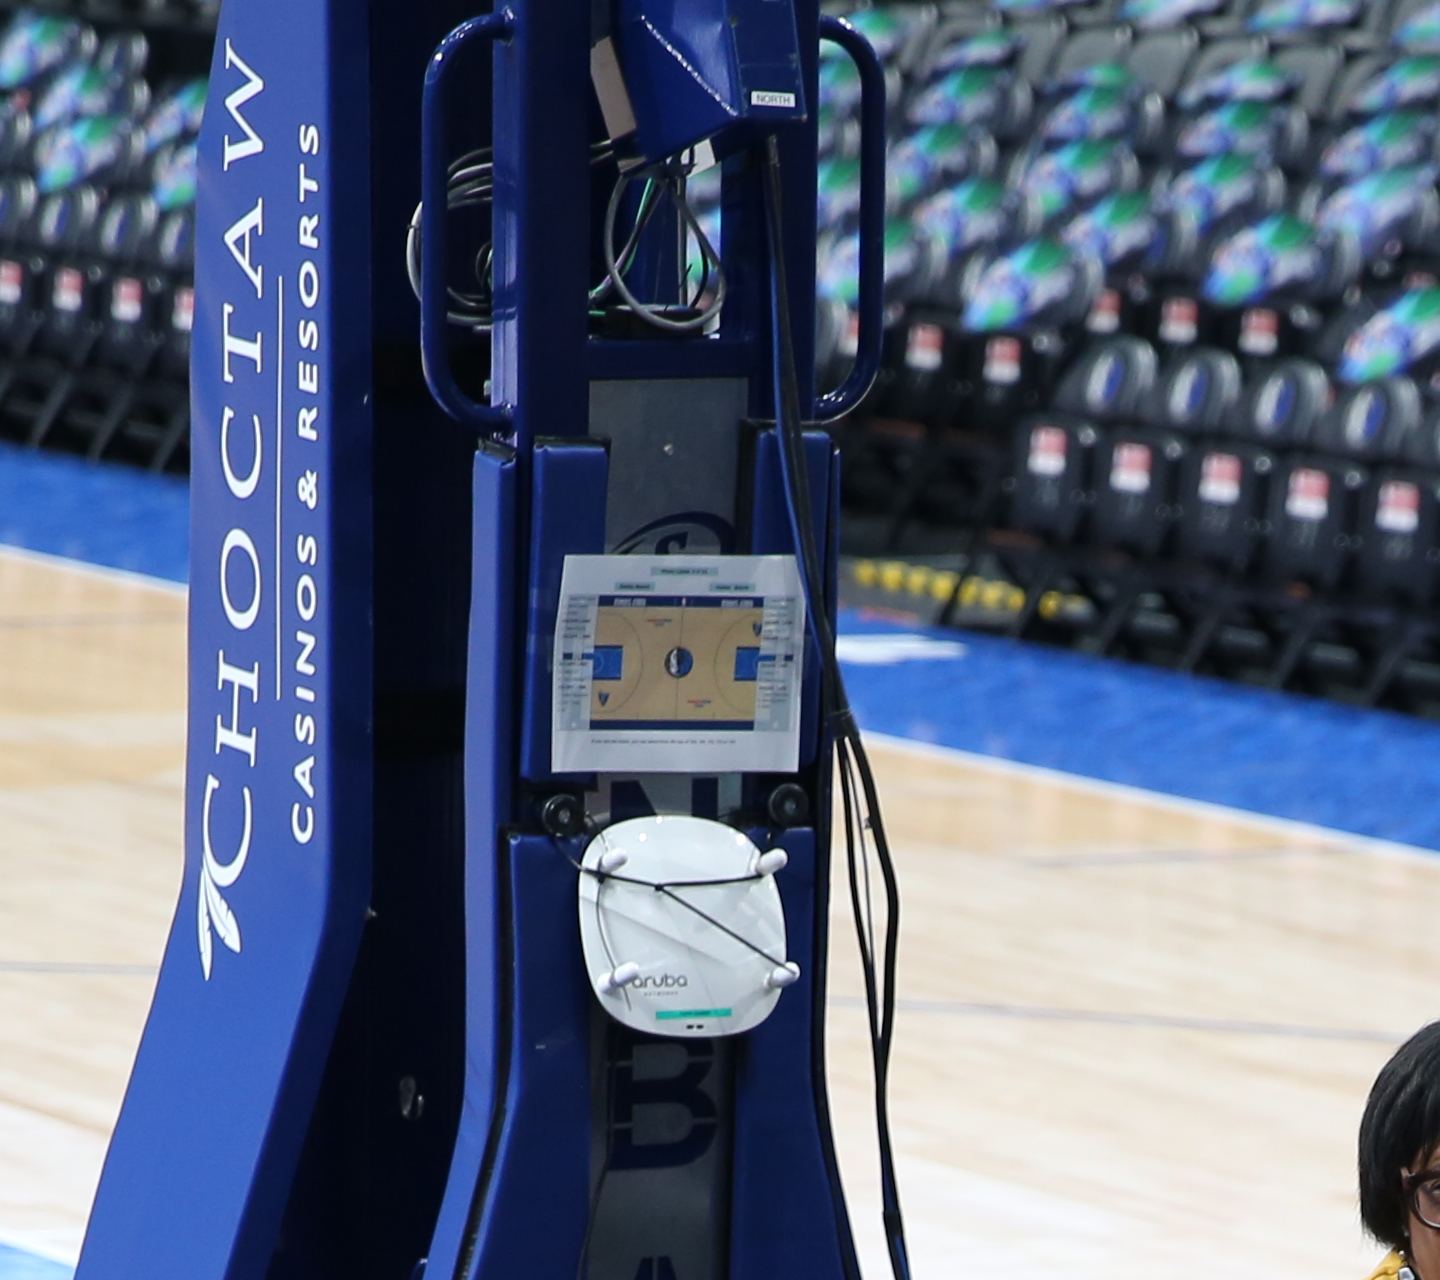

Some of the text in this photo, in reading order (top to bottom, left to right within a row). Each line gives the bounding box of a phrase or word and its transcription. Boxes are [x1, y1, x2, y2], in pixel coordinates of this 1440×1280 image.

[756, 94, 791, 104] NORTH
[201, 37, 265, 895] CHOCTAW
[291, 123, 320, 845] CASINOS & RESORTS
[631, 972, 688, 989] aruba
